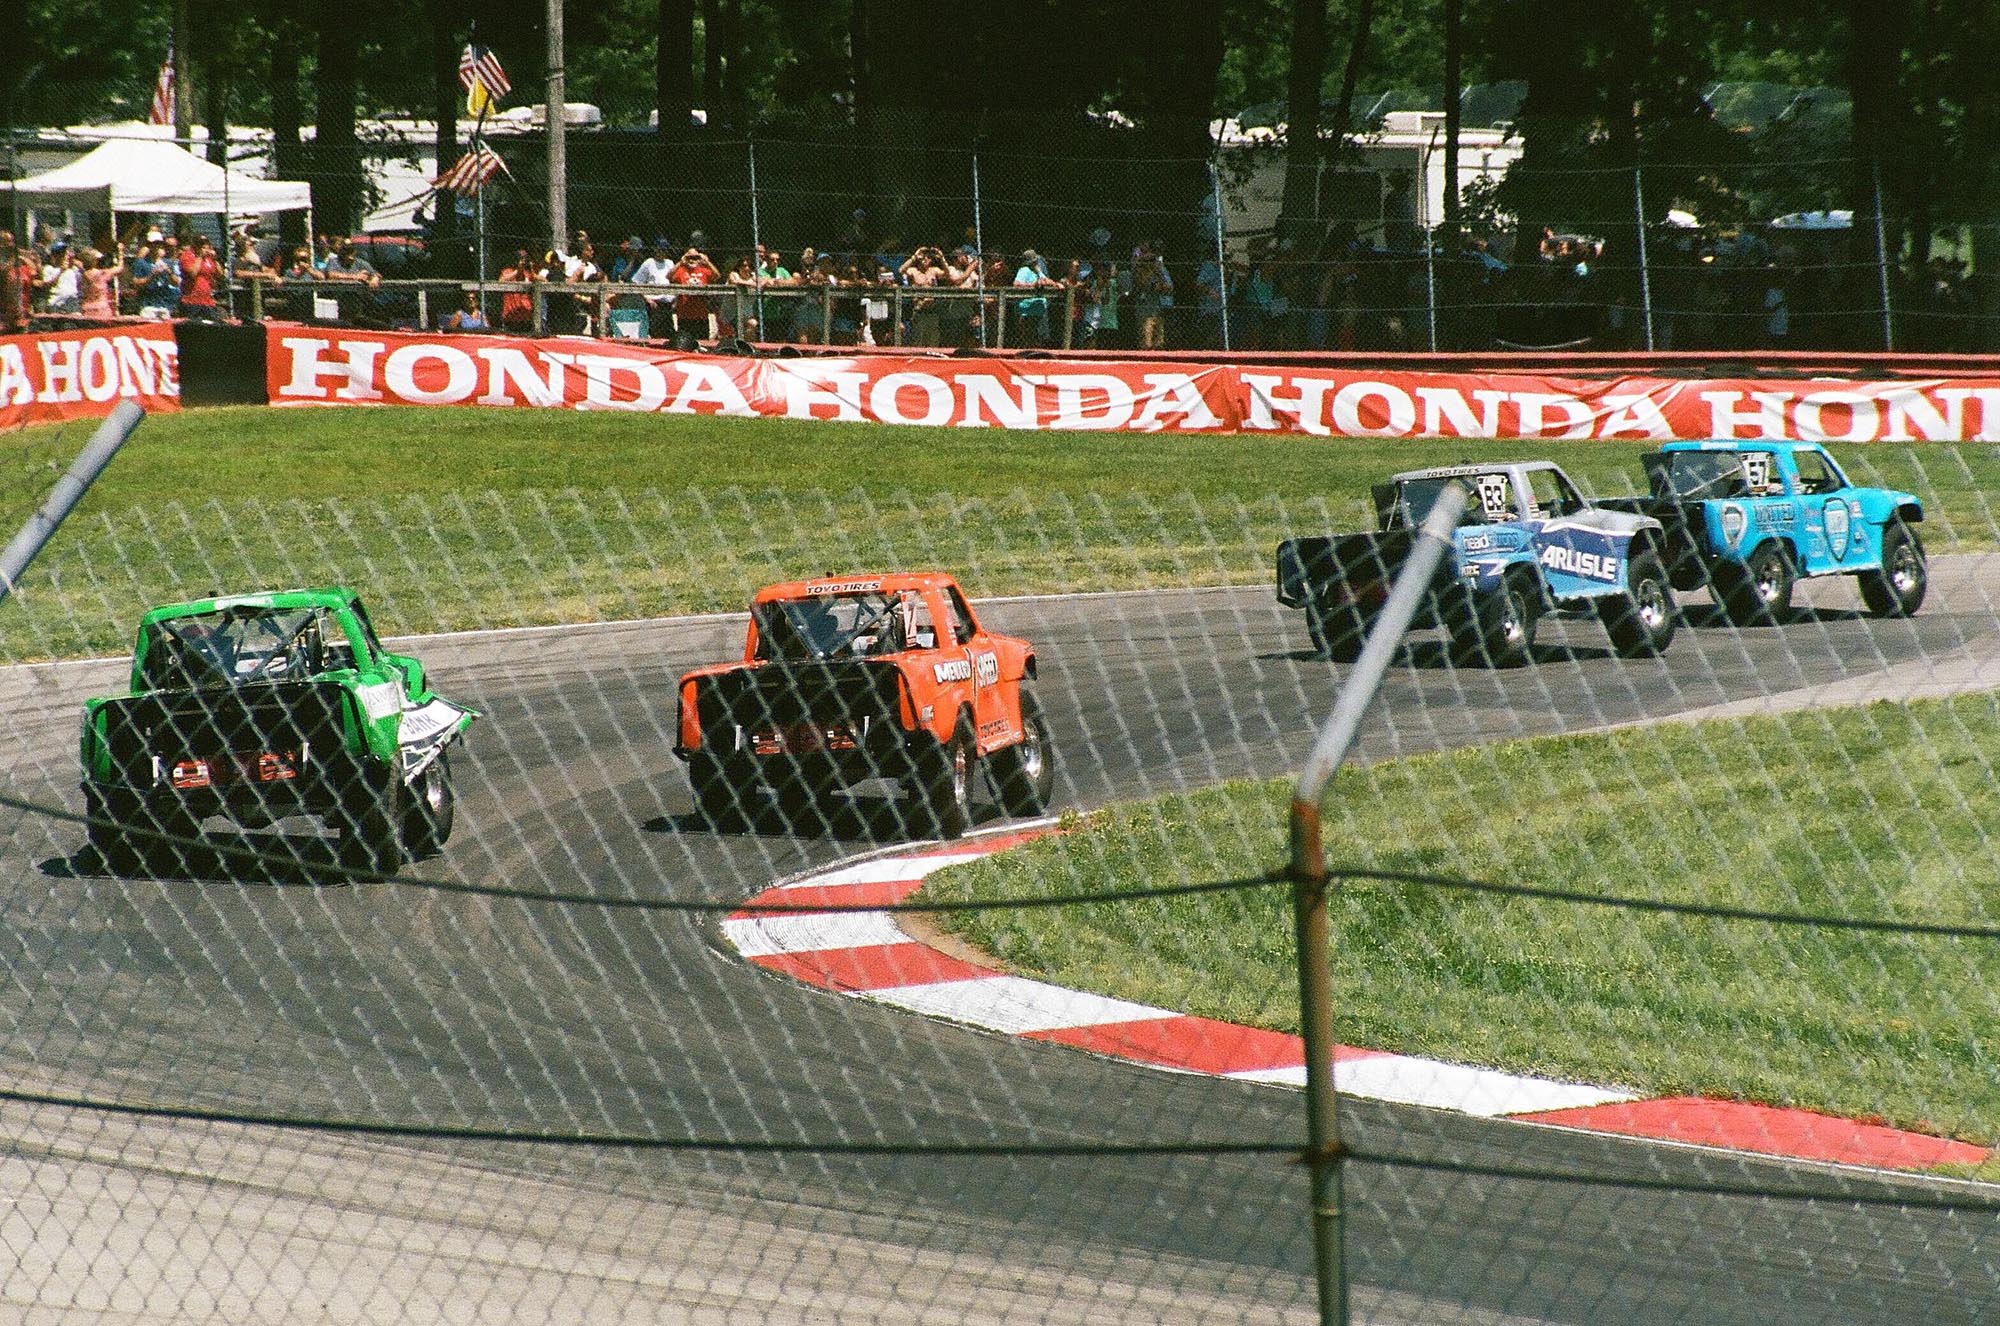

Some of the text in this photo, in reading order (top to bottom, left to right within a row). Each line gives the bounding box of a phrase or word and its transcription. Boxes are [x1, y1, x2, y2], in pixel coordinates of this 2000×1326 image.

[279, 337, 761, 418] HONDA
[774, 370, 1225, 433] HONDA
[1240, 373, 1676, 440] HONDA
[806, 582, 880, 595] TOYO TIRES
